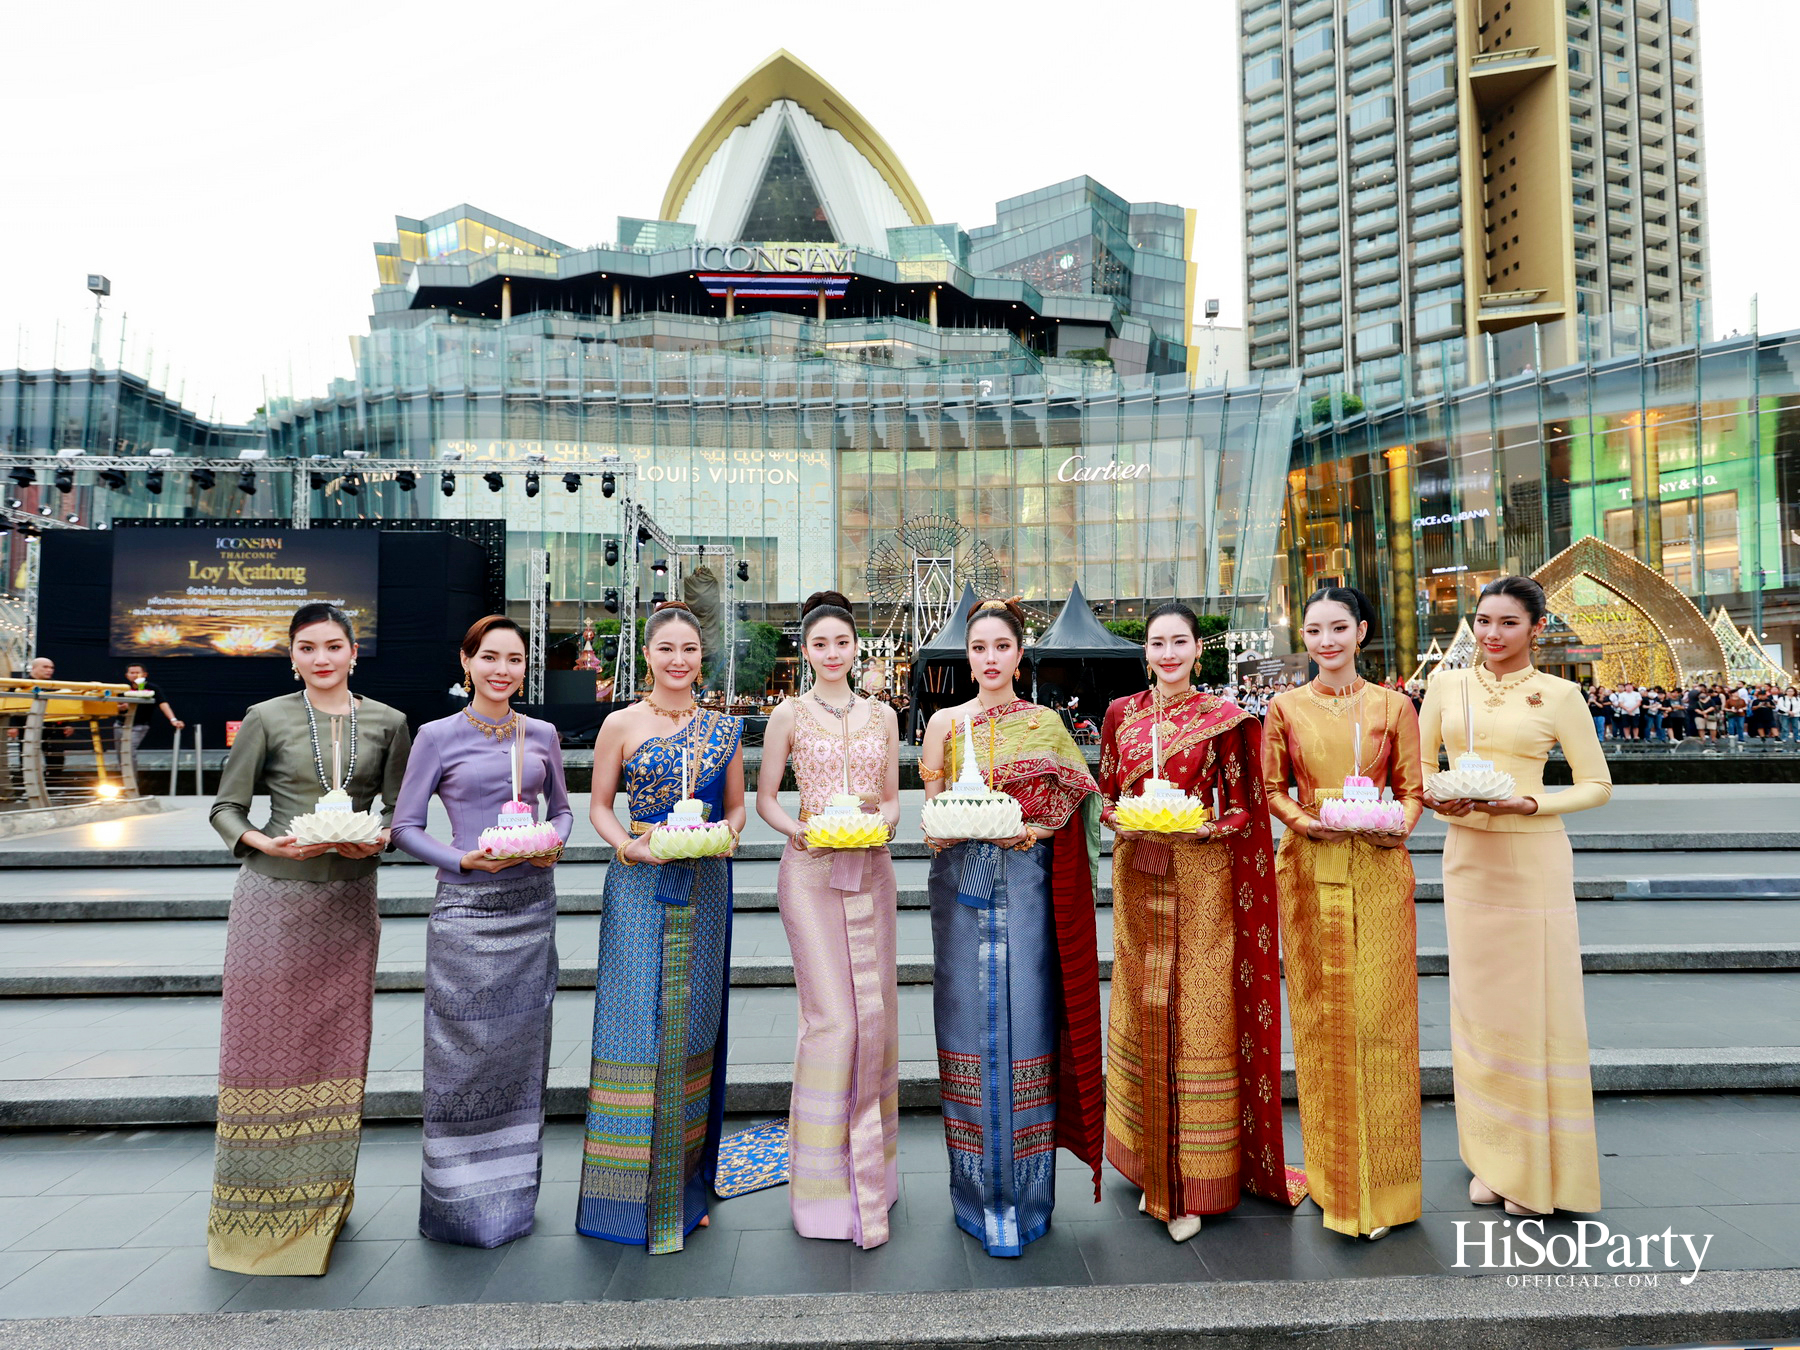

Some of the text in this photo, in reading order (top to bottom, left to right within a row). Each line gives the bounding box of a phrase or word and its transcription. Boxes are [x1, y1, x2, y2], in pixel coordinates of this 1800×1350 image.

[691, 245, 855, 273] ICONSIAM
[637, 466, 800, 485] LOUIS VUITTON
[1057, 455, 1151, 482] Cartier
[215, 537, 283, 550] ICONSIAM
[220, 551, 278, 560] THAICONIC
[188, 560, 307, 585] Loy Krathong
